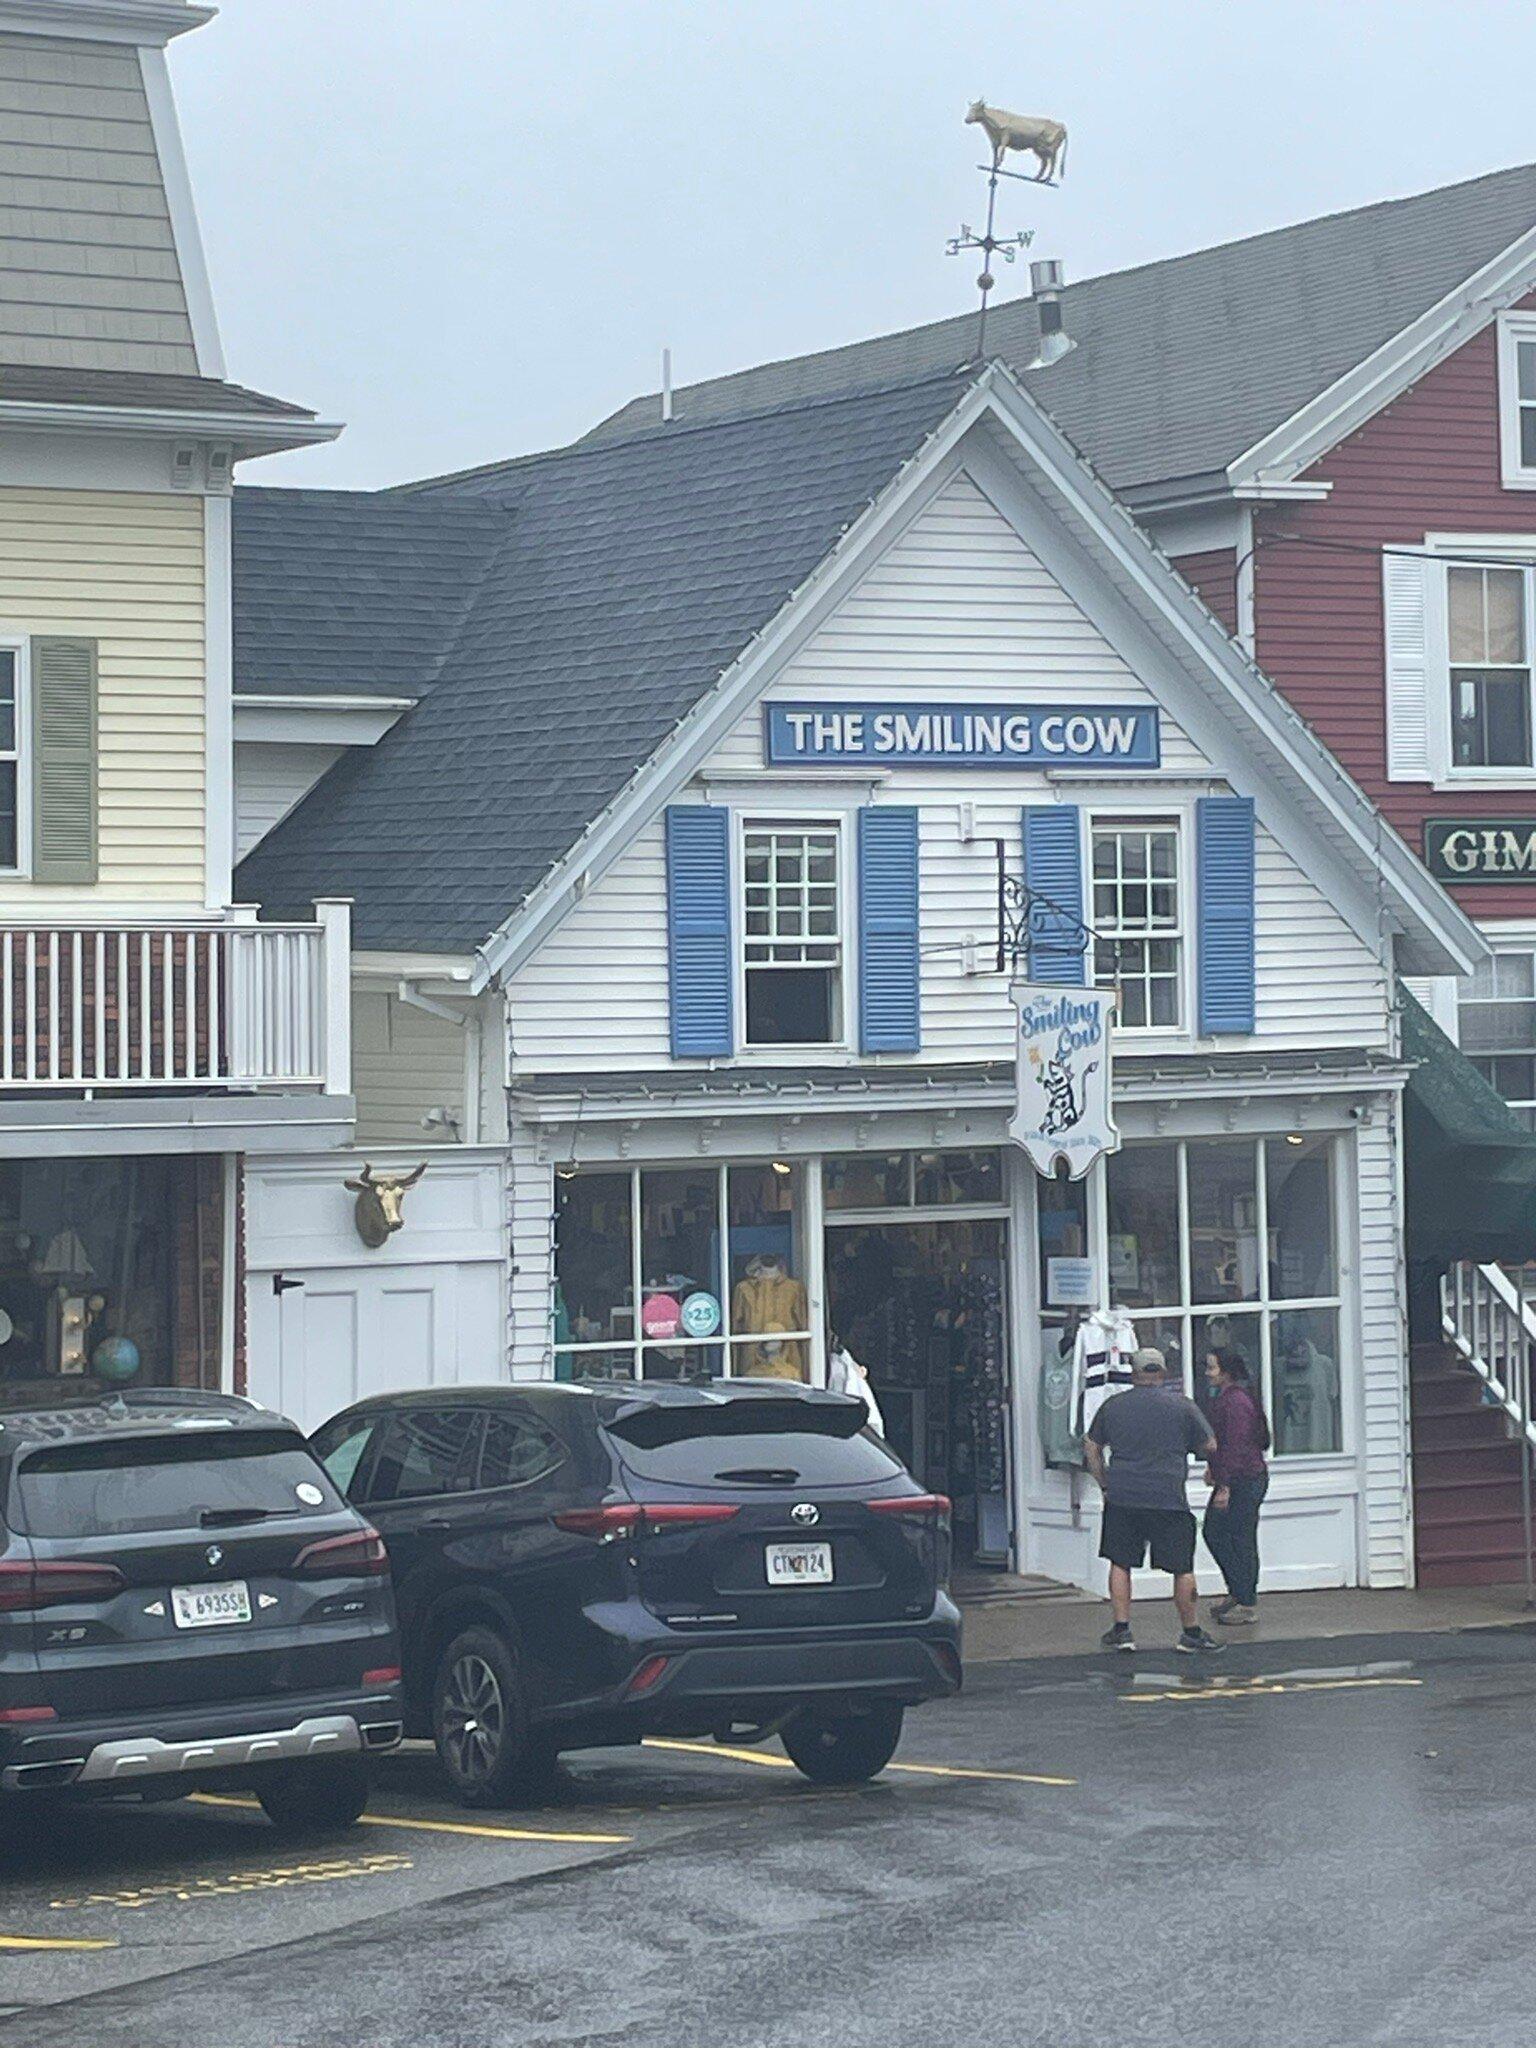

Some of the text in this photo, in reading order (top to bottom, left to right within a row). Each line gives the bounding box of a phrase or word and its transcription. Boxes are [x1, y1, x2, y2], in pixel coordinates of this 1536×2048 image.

[786, 714, 1136, 754] THE SMILING COW
[1440, 829, 1536, 872] GIM
[1021, 996, 1101, 1040] Smiling
[1057, 1024, 1102, 1061] Cow
